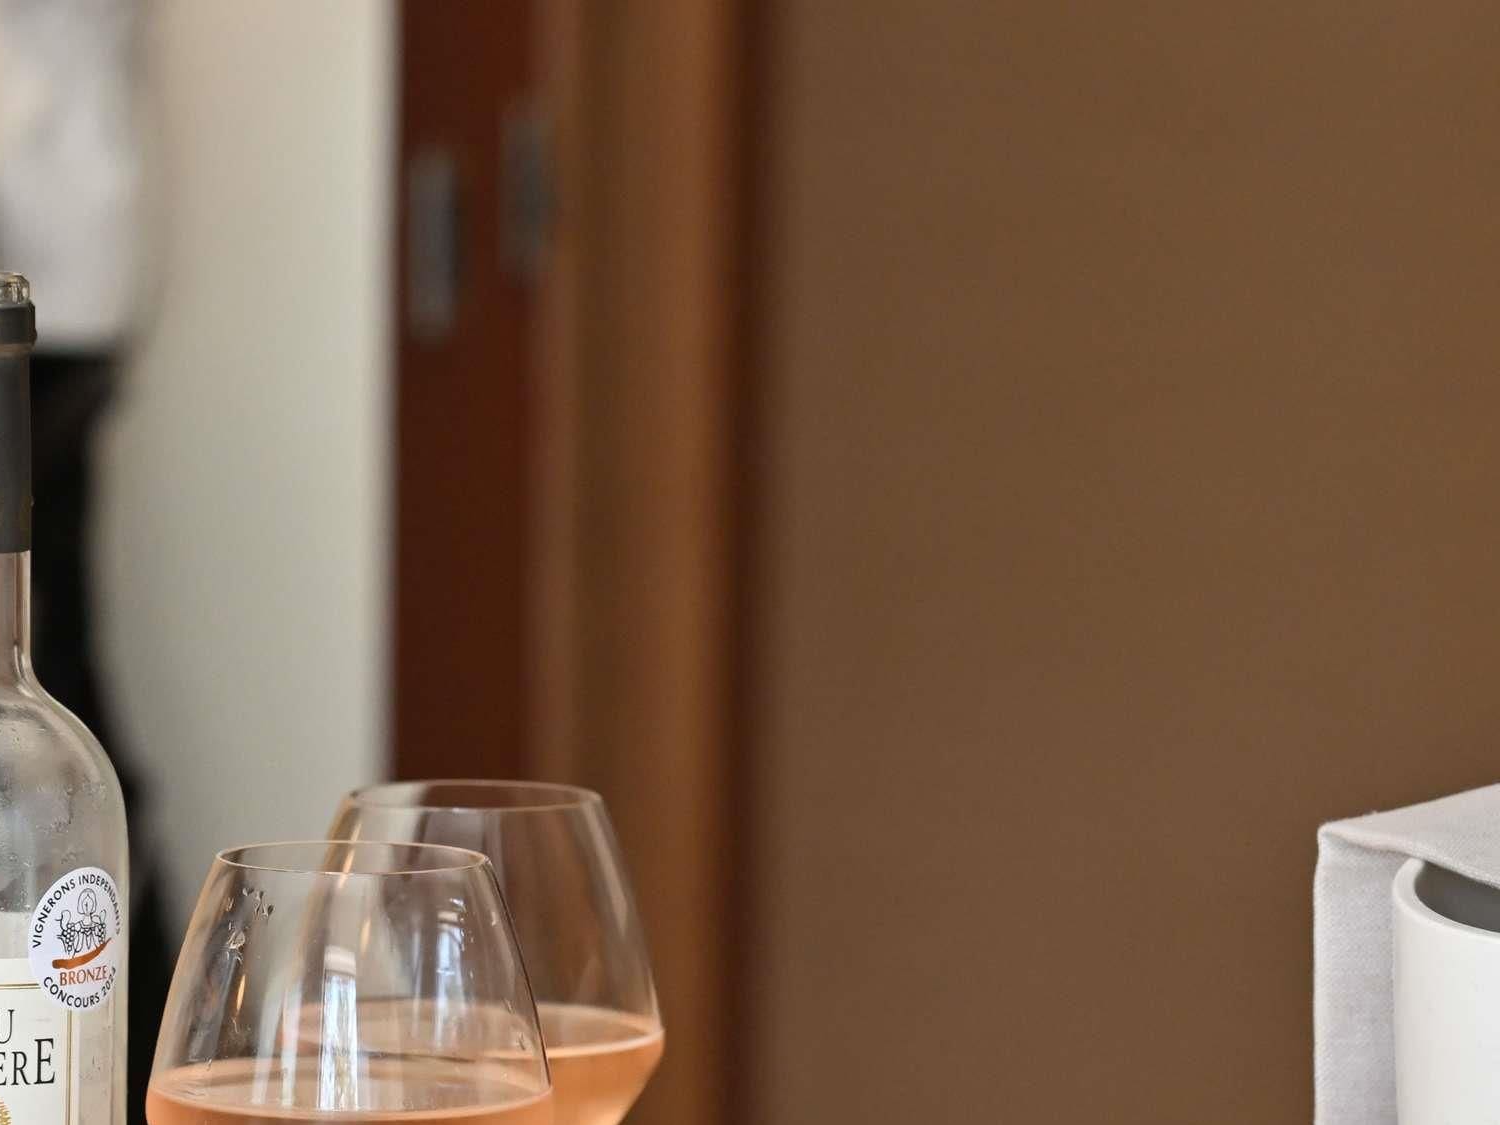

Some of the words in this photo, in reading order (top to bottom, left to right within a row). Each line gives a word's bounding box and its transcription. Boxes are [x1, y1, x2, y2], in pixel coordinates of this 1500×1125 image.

[32, 878, 76, 948] VIGNERONS
[43, 976, 100, 1009] CONCOURS
[59, 965, 108, 987] BRONZE
